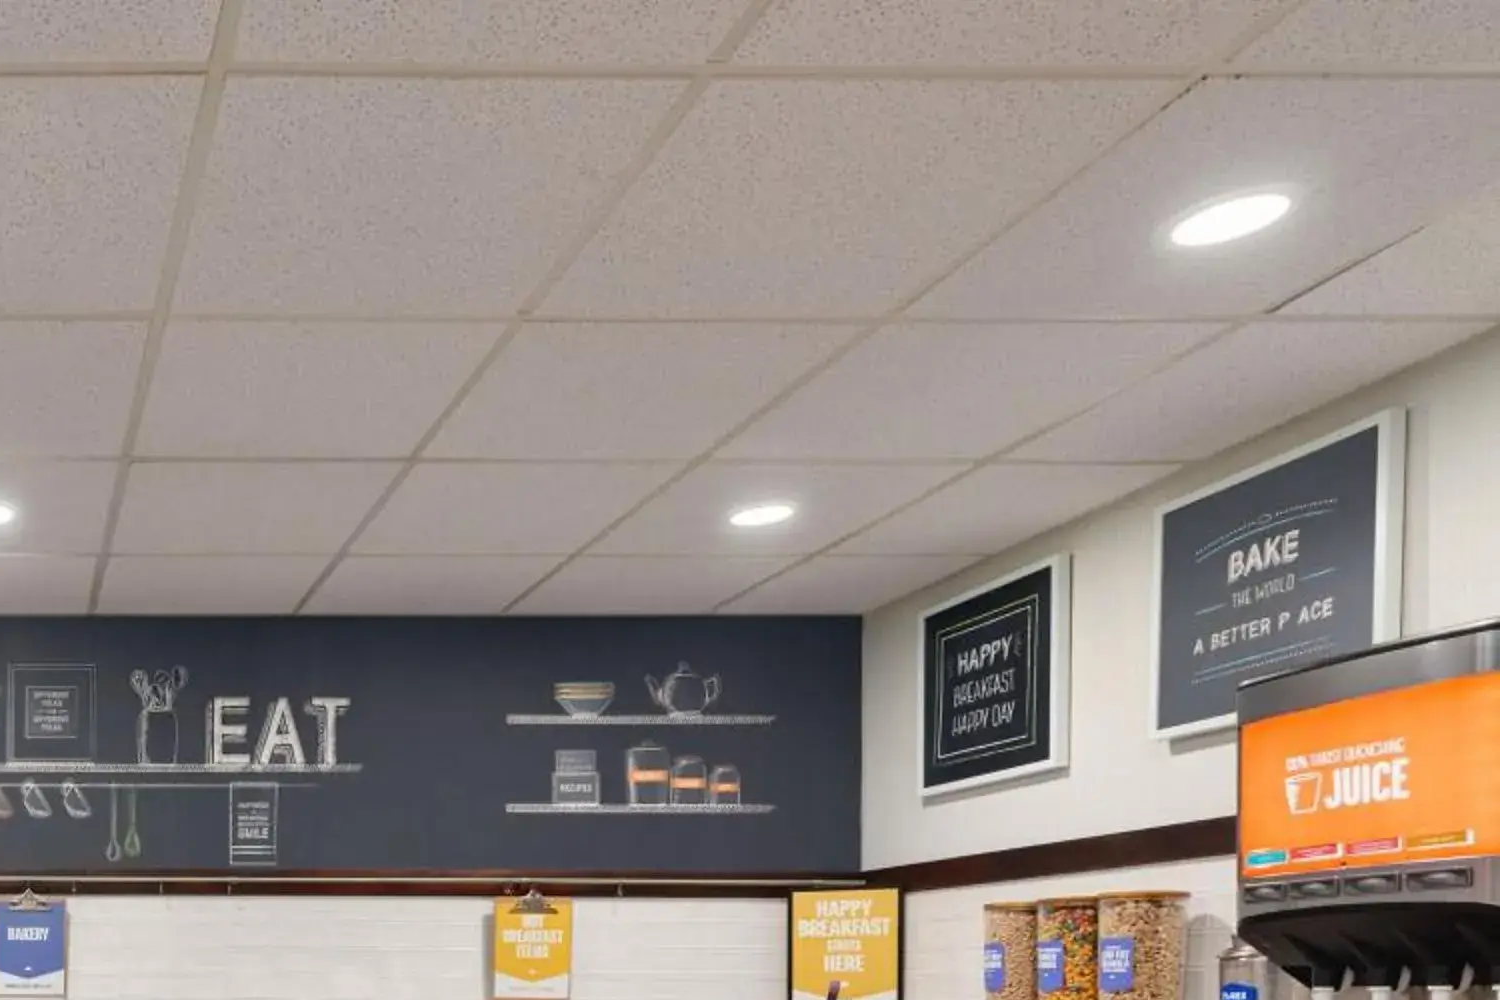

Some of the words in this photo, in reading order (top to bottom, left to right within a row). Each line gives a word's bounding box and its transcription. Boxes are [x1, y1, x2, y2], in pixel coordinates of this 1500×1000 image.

[1227, 529, 1301, 586] BAKE
[1232, 587, 1252, 608] THE
[1254, 573, 1296, 603] WORLD
[957, 633, 1013, 677] HAPPY
[1193, 637, 1204, 656] A
[1210, 616, 1272, 651] BETTER
[953, 667, 1016, 708] BREAKFAST
[206, 696, 351, 769] EAT
[951, 707, 990, 736] HAPPY
[992, 700, 1016, 727] DAY
[1324, 756, 1411, 809] JUICE
[816, 898, 873, 918] HAPPY
[7, 927, 49, 941] BAKERY
[798, 917, 890, 938] BREAKFAST
[824, 954, 867, 973] HERE
